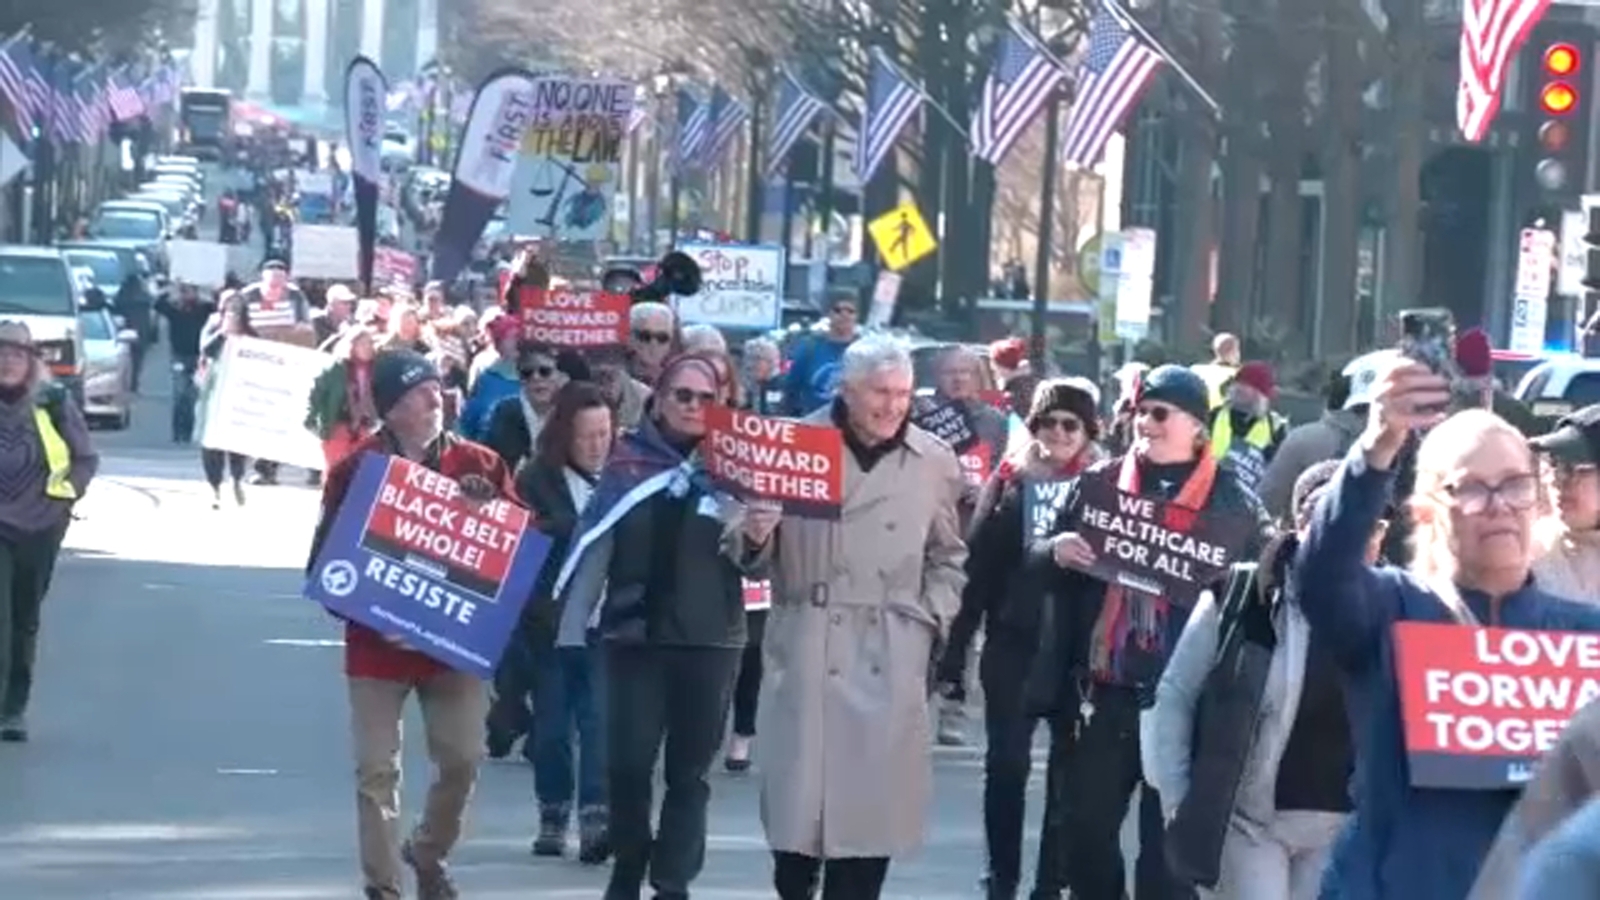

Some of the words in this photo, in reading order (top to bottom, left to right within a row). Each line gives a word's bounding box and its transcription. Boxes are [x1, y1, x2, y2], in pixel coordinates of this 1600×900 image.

[573, 84, 631, 114] ONE
[523, 308, 620, 326] FORWARD
[544, 289, 596, 309] LOVE
[523, 325, 620, 345] TOGETHER
[731, 412, 797, 445] LOVE
[712, 429, 831, 475] FORWARD
[404, 462, 462, 501] KEEP
[712, 452, 831, 500] TOGETHER
[380, 484, 459, 531] BLACK
[461, 516, 517, 554] BELT
[479, 499, 511, 524] HE
[1118, 494, 1155, 519] WE
[393, 516, 487, 570] WHOLE!
[1081, 504, 1226, 567] HEALTHCARE
[1103, 535, 1149, 566] FOR
[1153, 553, 1194, 582] ALL
[365, 558, 477, 626] RESISTE
[1475, 629, 1600, 669] LOVE
[1425, 711, 1567, 752] TOGE
